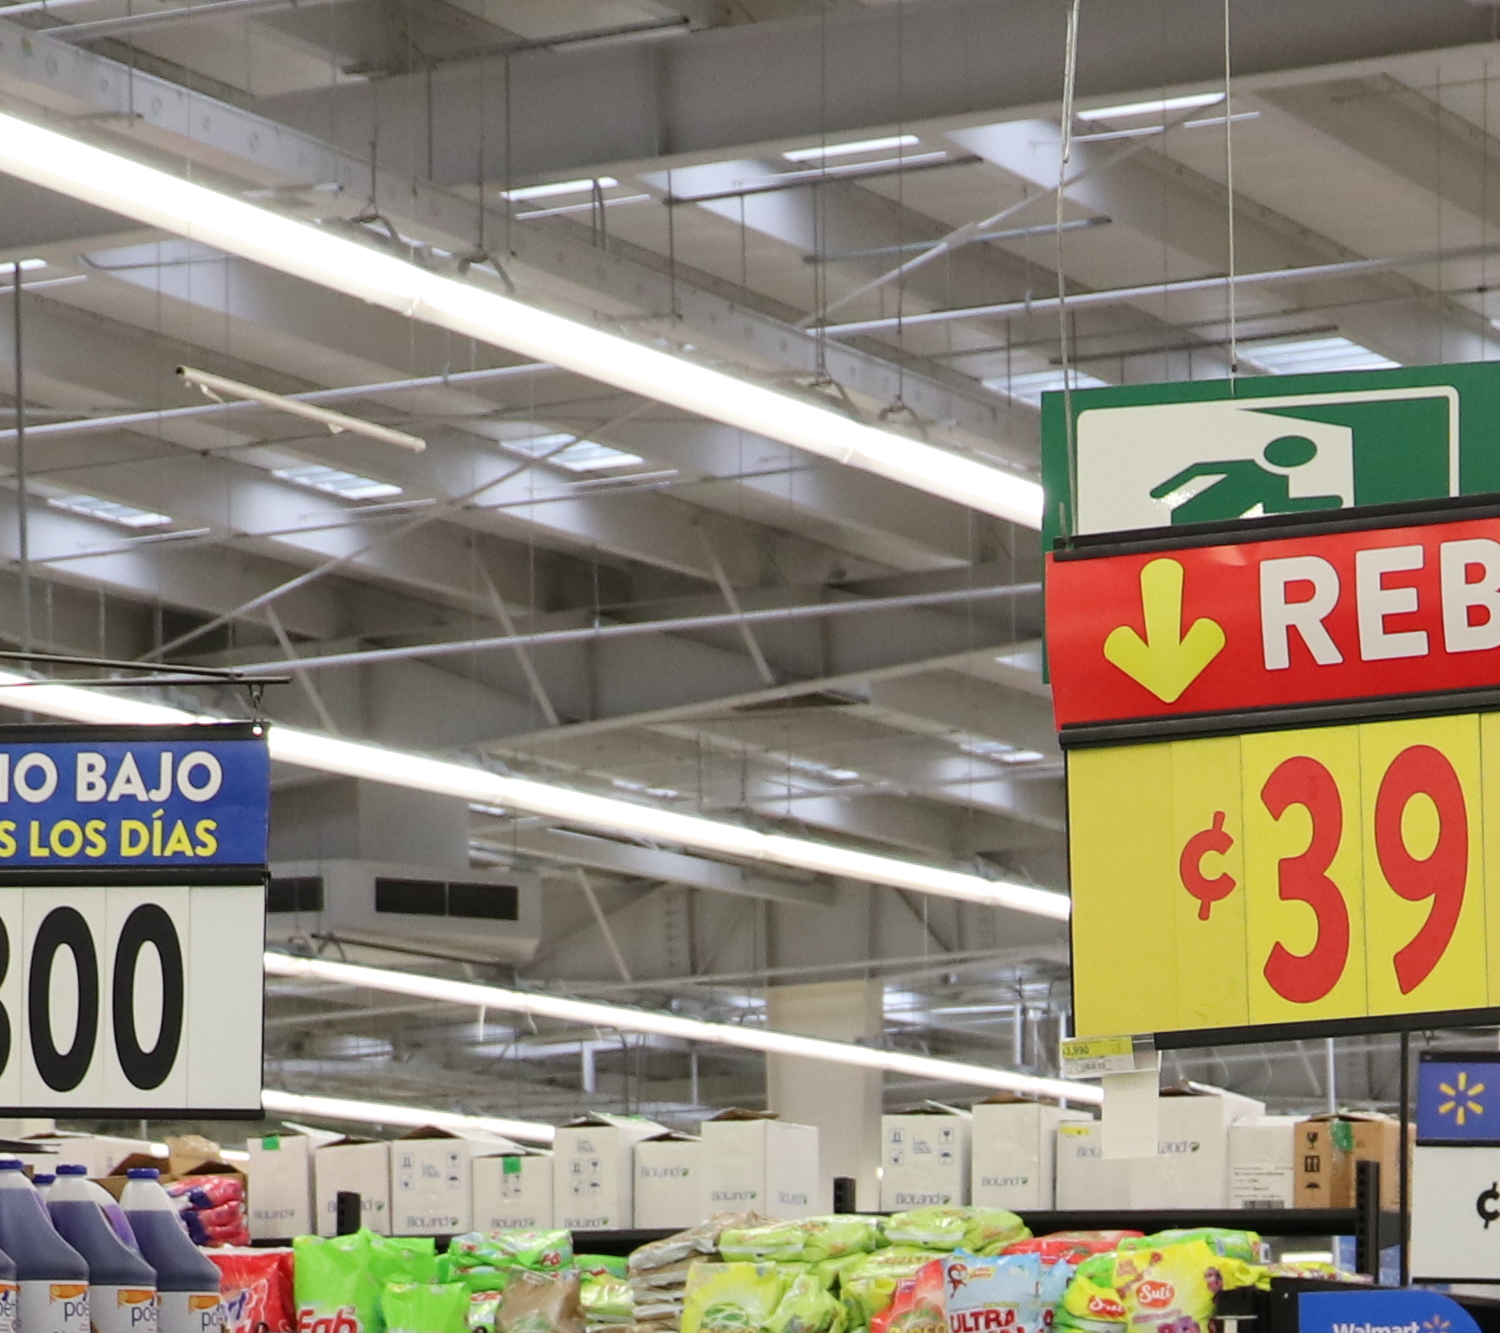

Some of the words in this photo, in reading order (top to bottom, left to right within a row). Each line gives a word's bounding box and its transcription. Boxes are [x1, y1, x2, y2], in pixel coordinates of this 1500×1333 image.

[76, 750, 224, 803] BAJO
[29, 819, 107, 858] LOS
[120, 808, 219, 857] DÍAS
